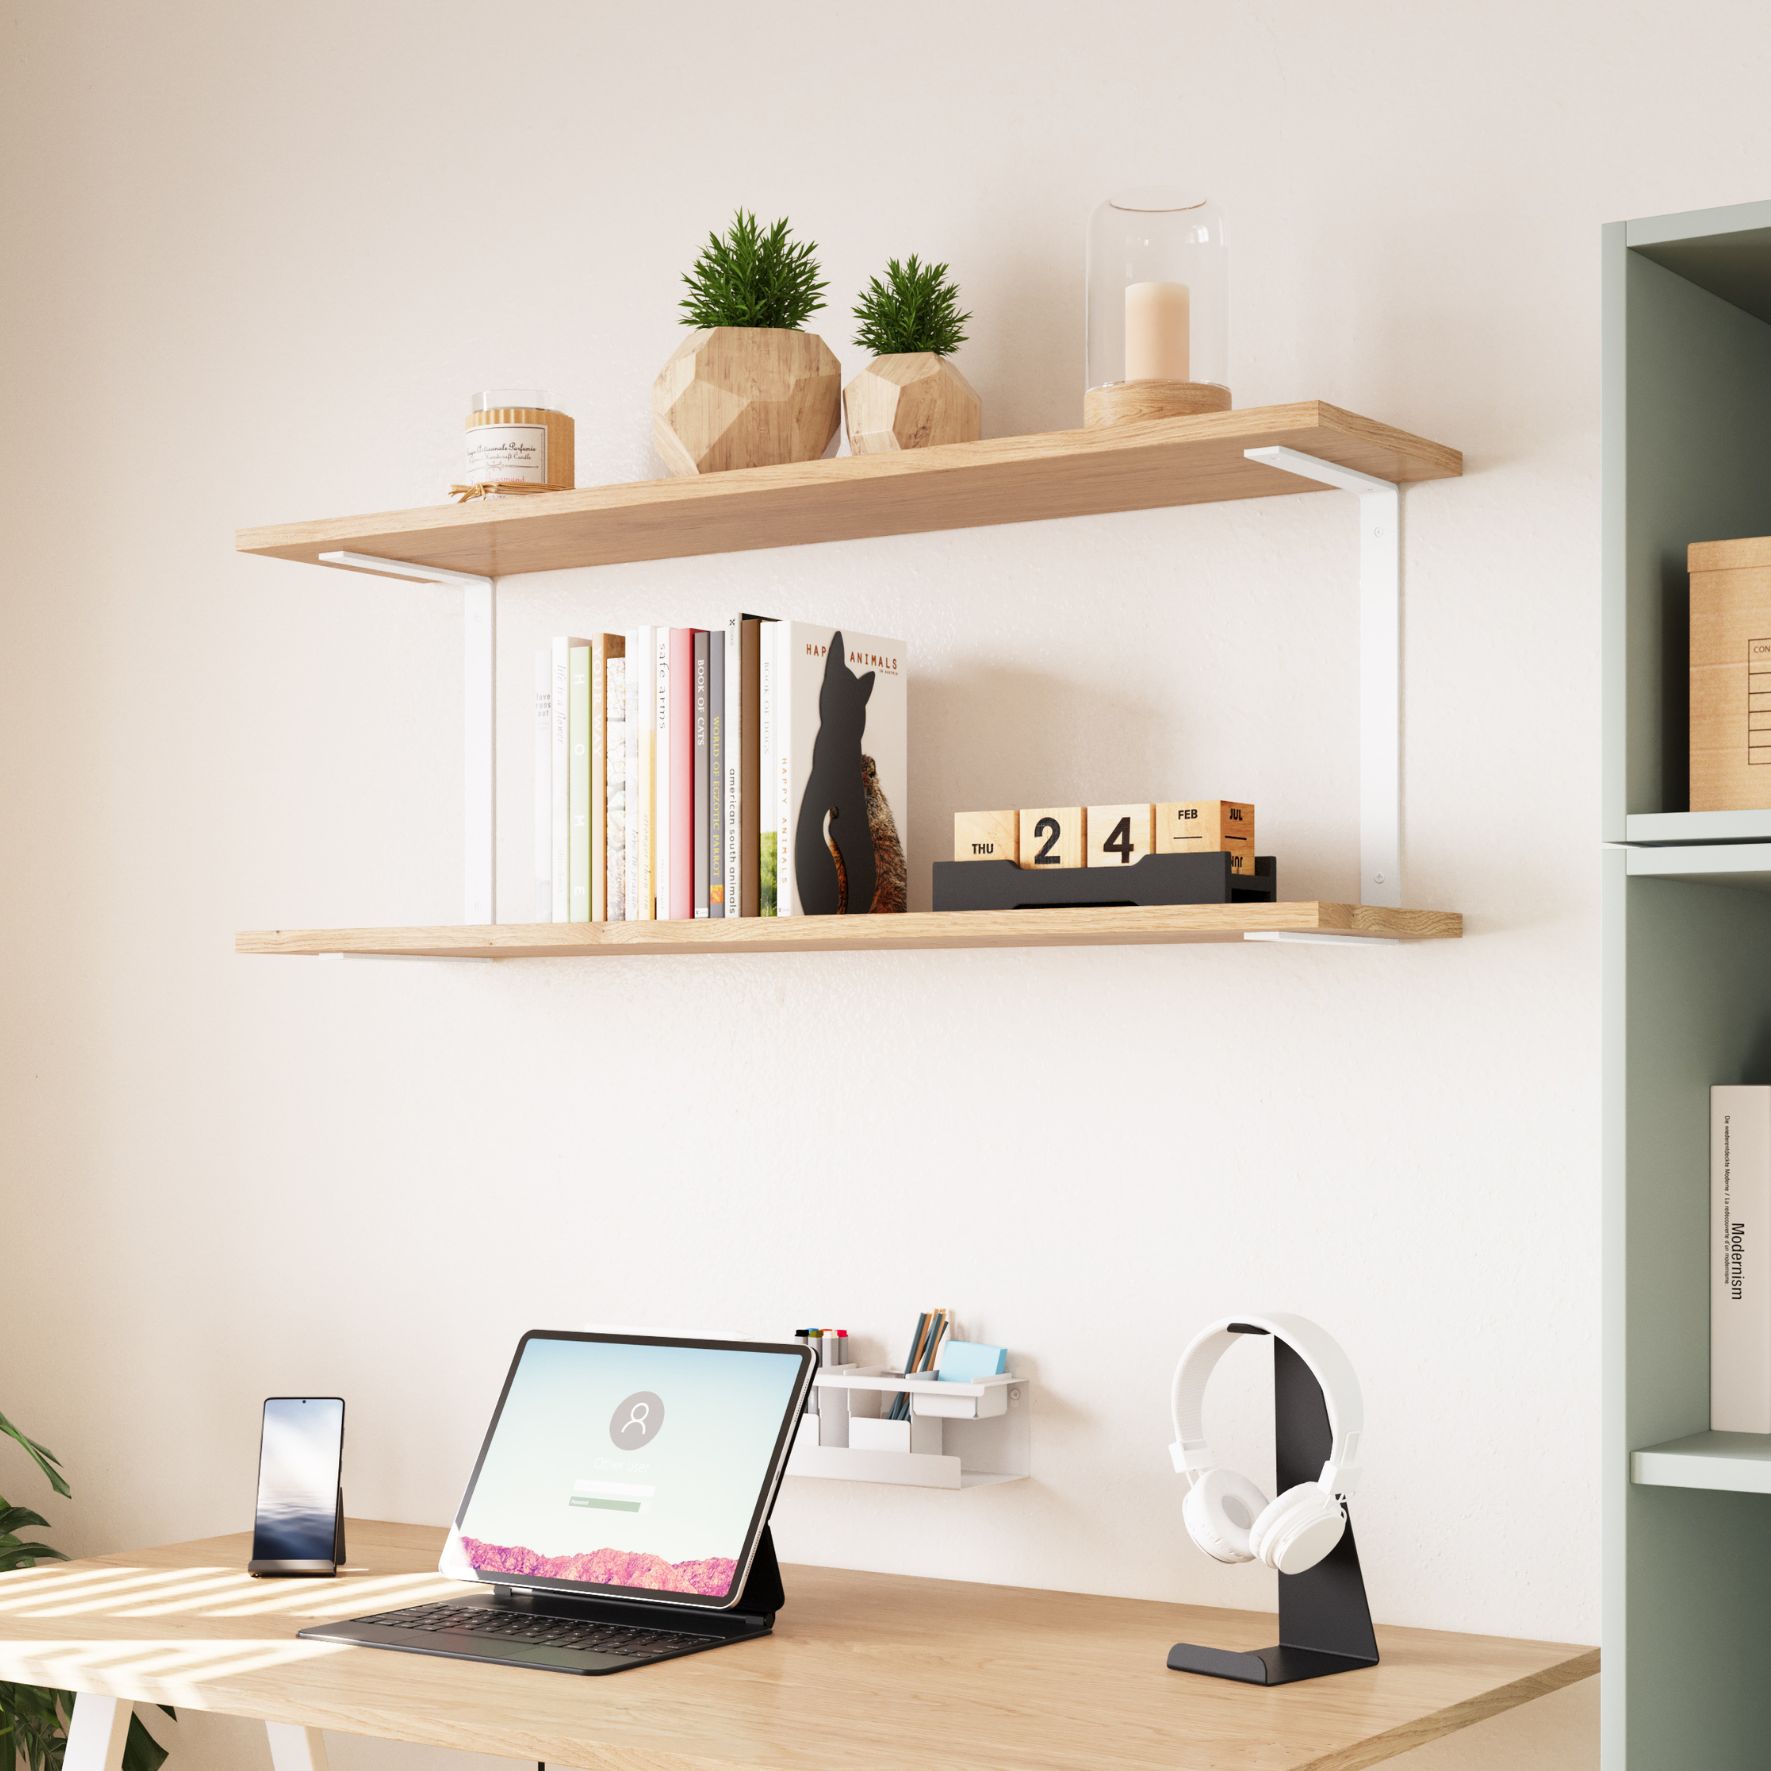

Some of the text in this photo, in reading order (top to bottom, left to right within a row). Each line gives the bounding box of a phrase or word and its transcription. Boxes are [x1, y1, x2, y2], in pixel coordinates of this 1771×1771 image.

[658, 643, 669, 677] safe
[806, 643, 897, 670] HAP ANIMALS
[697, 659, 705, 746] BOOK OF CATS
[712, 716, 721, 877] WORLD OF EGZOTIC PARROT
[1178, 809, 1198, 820] FEB
[1229, 808, 1243, 821] JUL
[971, 843, 994, 855] THU
[1034, 816, 1061, 865] 2
[1103, 816, 1134, 864] 4
[1731, 1223, 1745, 1300] Modernism
